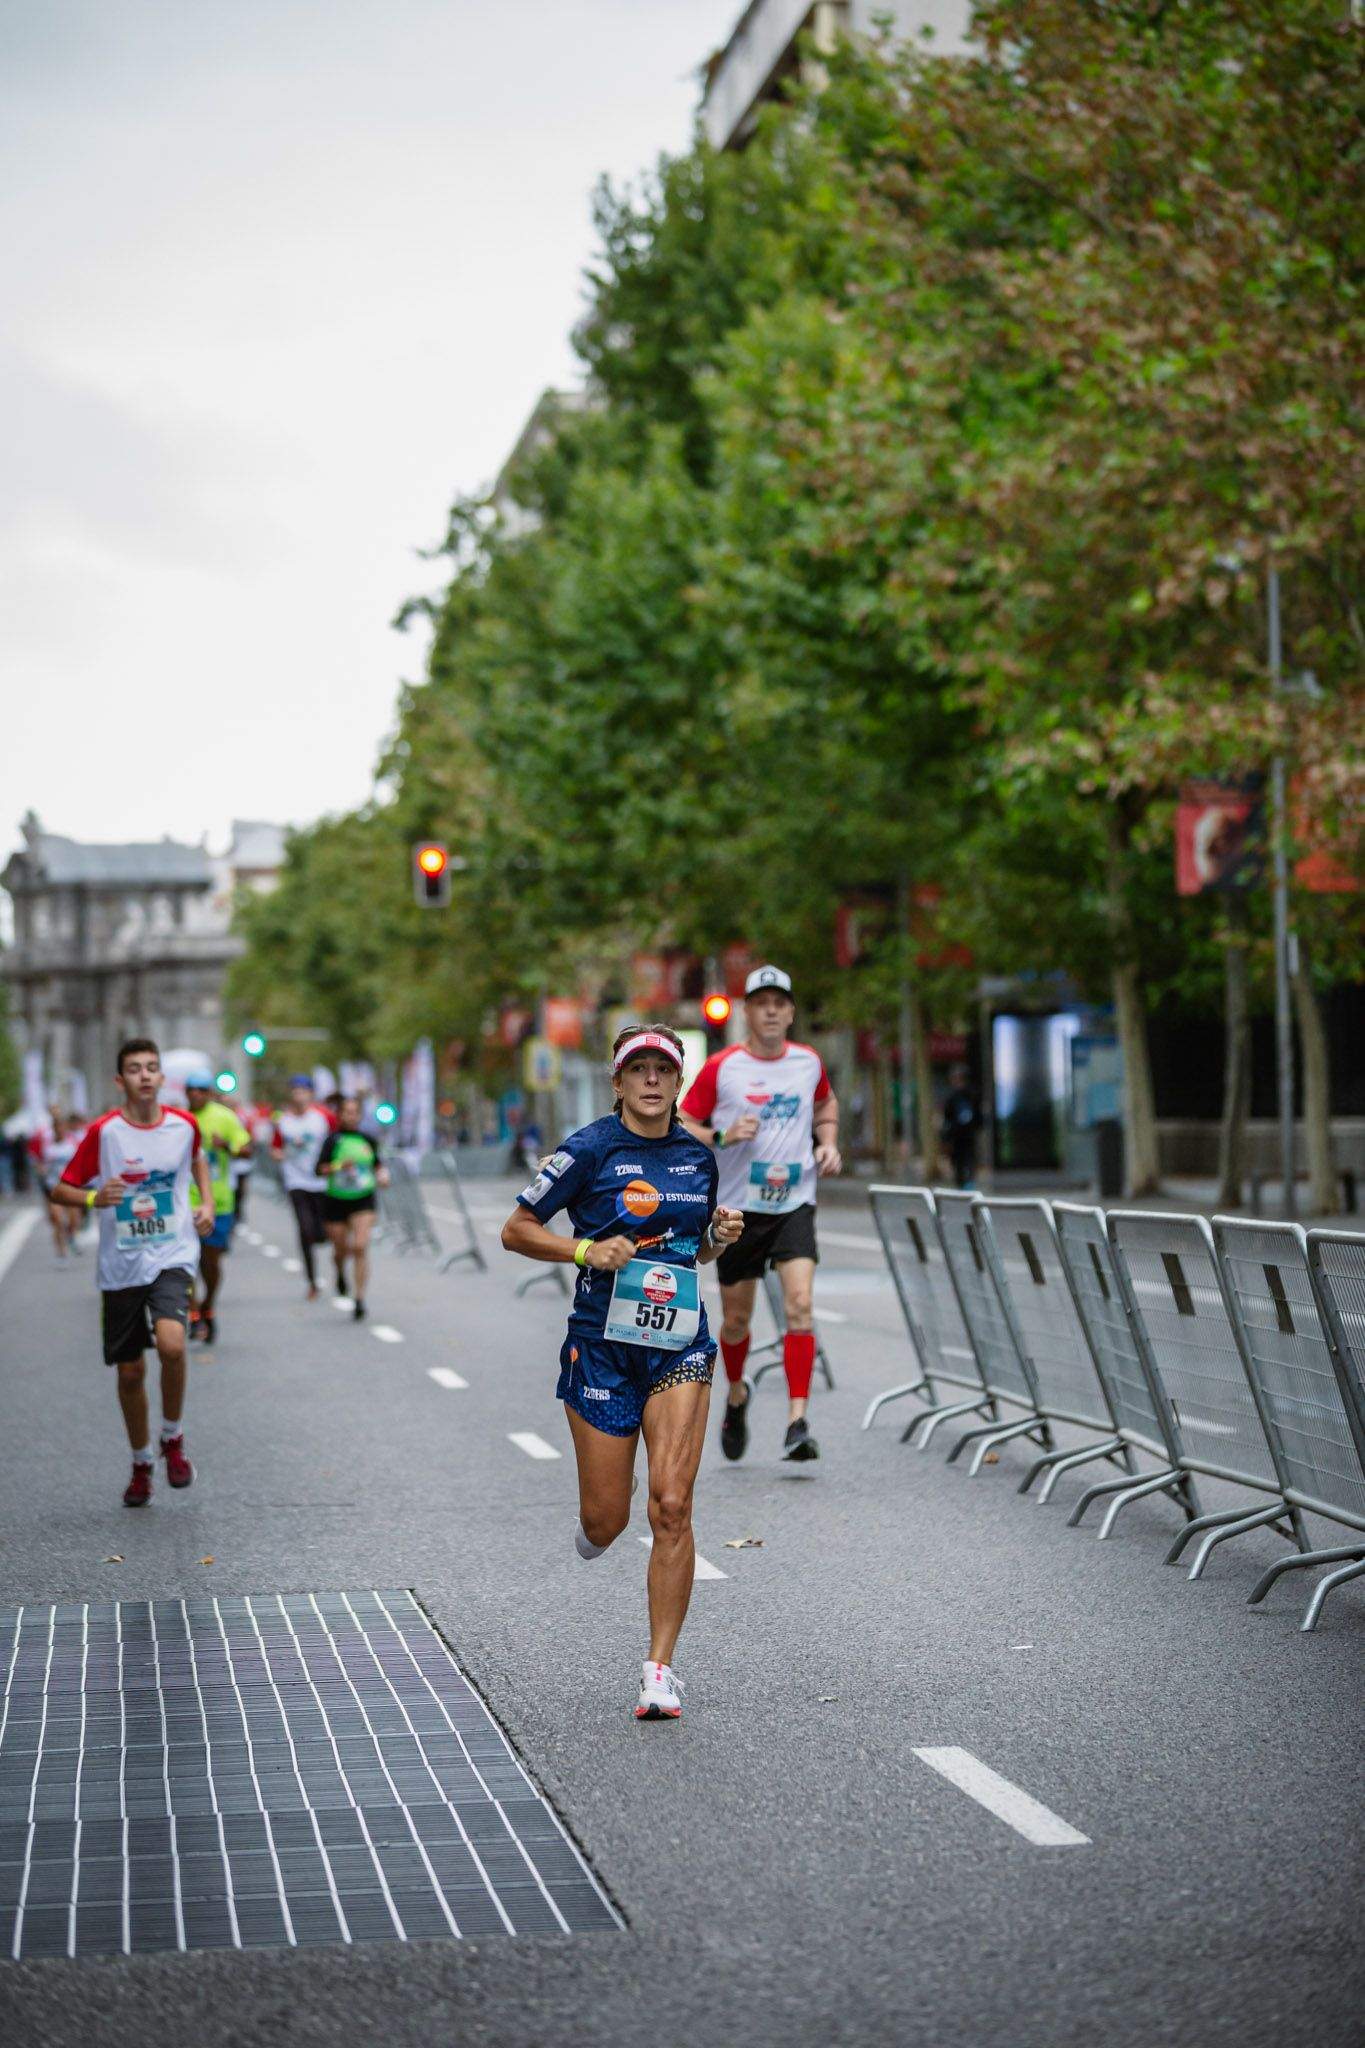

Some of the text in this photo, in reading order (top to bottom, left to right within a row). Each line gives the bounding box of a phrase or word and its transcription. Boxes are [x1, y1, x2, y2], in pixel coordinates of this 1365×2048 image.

[626, 1193, 664, 1202] COLEGIO
[129, 1217, 165, 1237] 1409
[635, 1302, 678, 1331] 557
